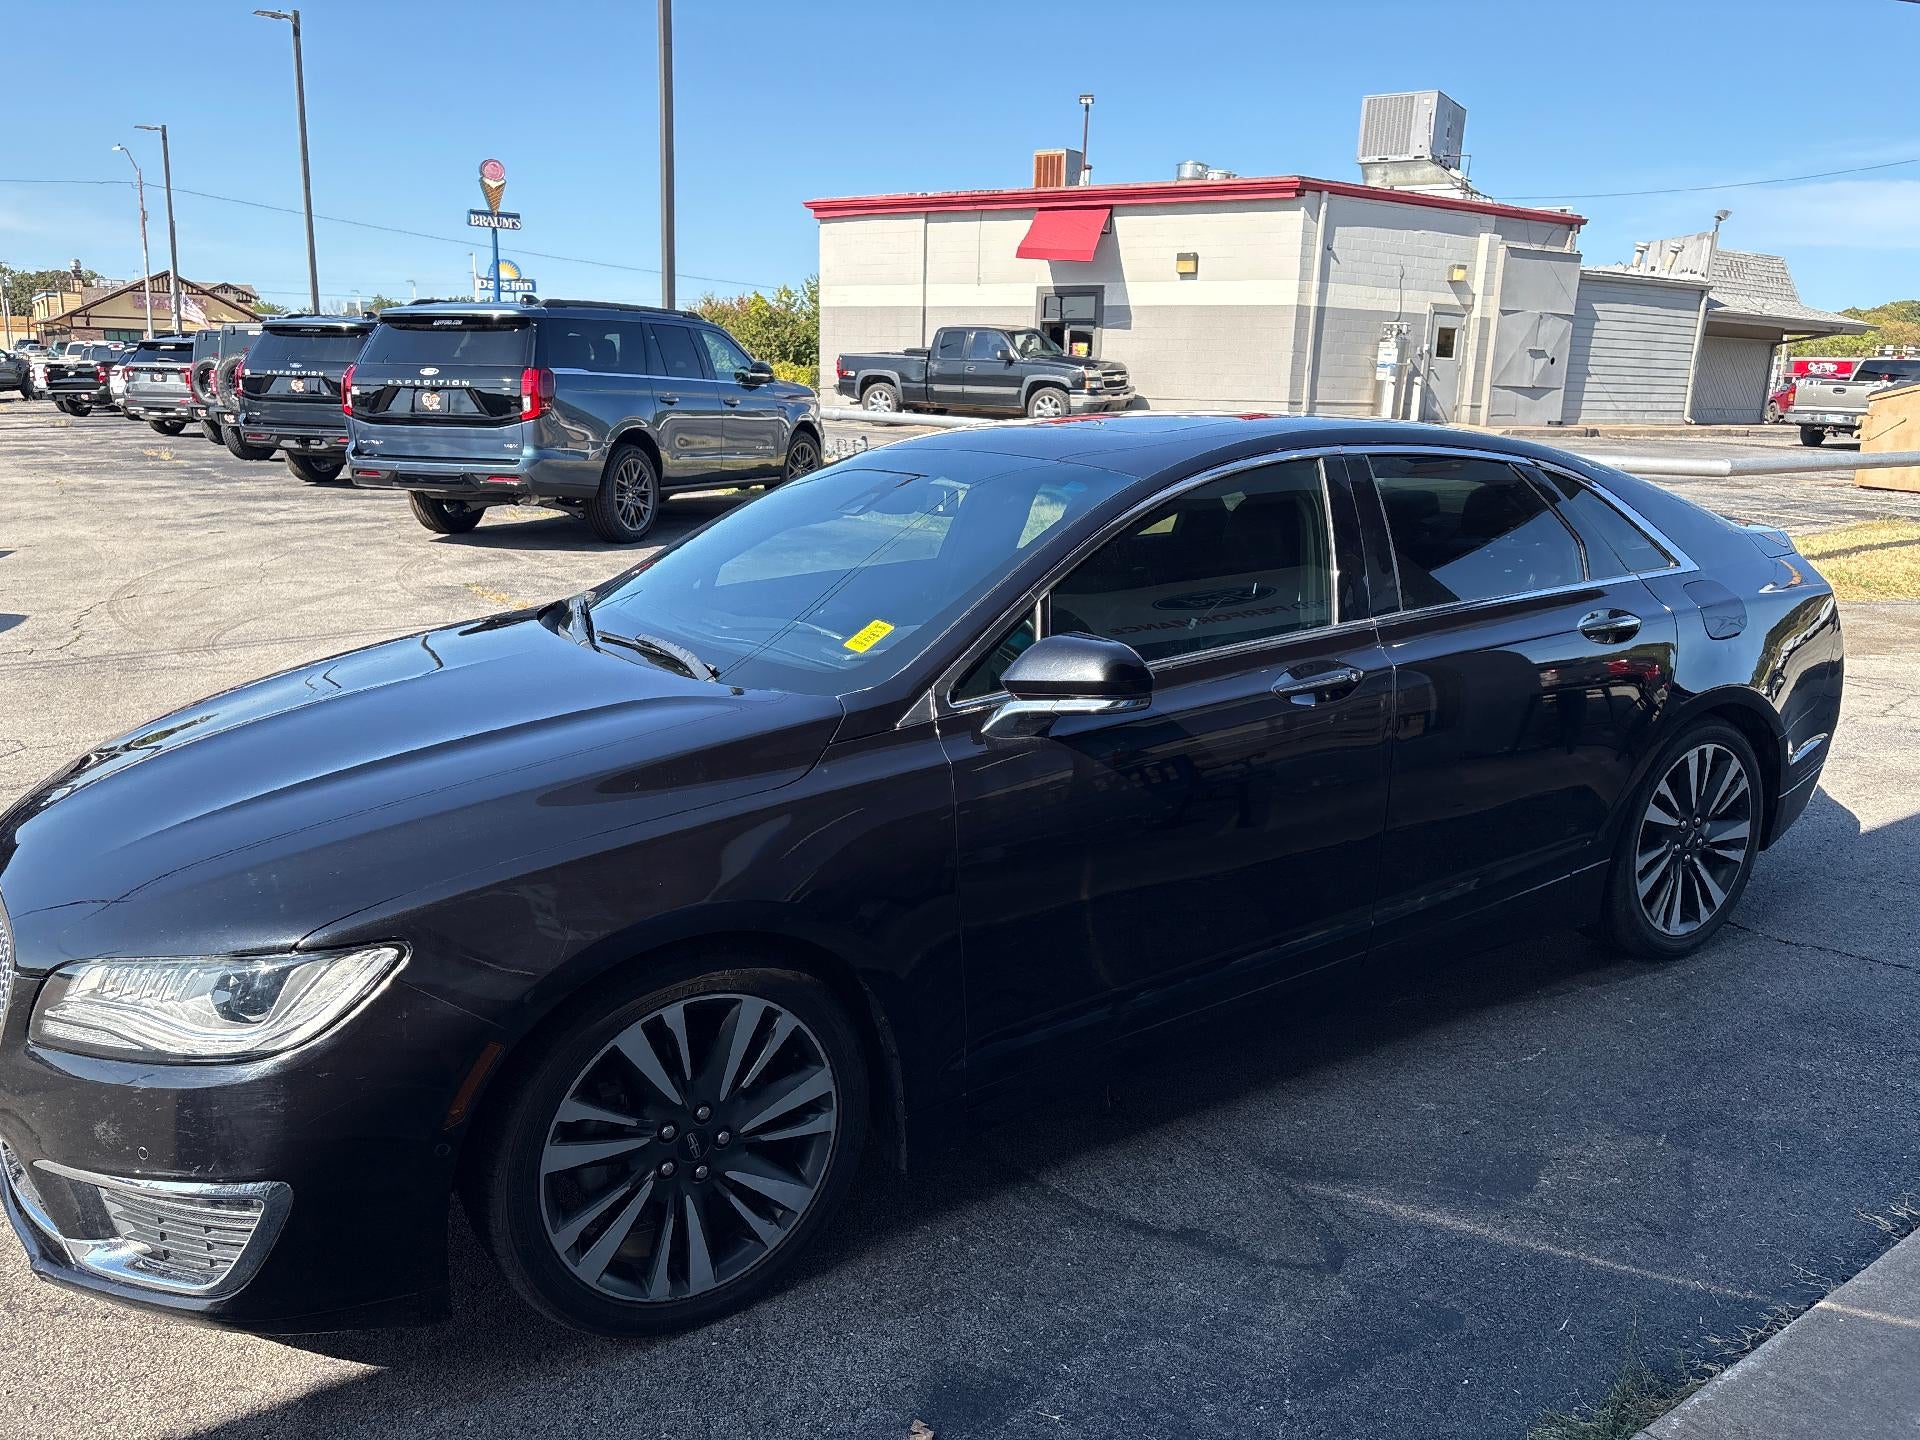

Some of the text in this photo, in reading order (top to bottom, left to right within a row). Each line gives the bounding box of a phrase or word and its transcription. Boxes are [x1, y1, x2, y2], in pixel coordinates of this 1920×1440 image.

[470, 214, 521, 229] BRAUM'S
[479, 279, 533, 291] Das Inn
[387, 379, 470, 387] EXPEDITION
